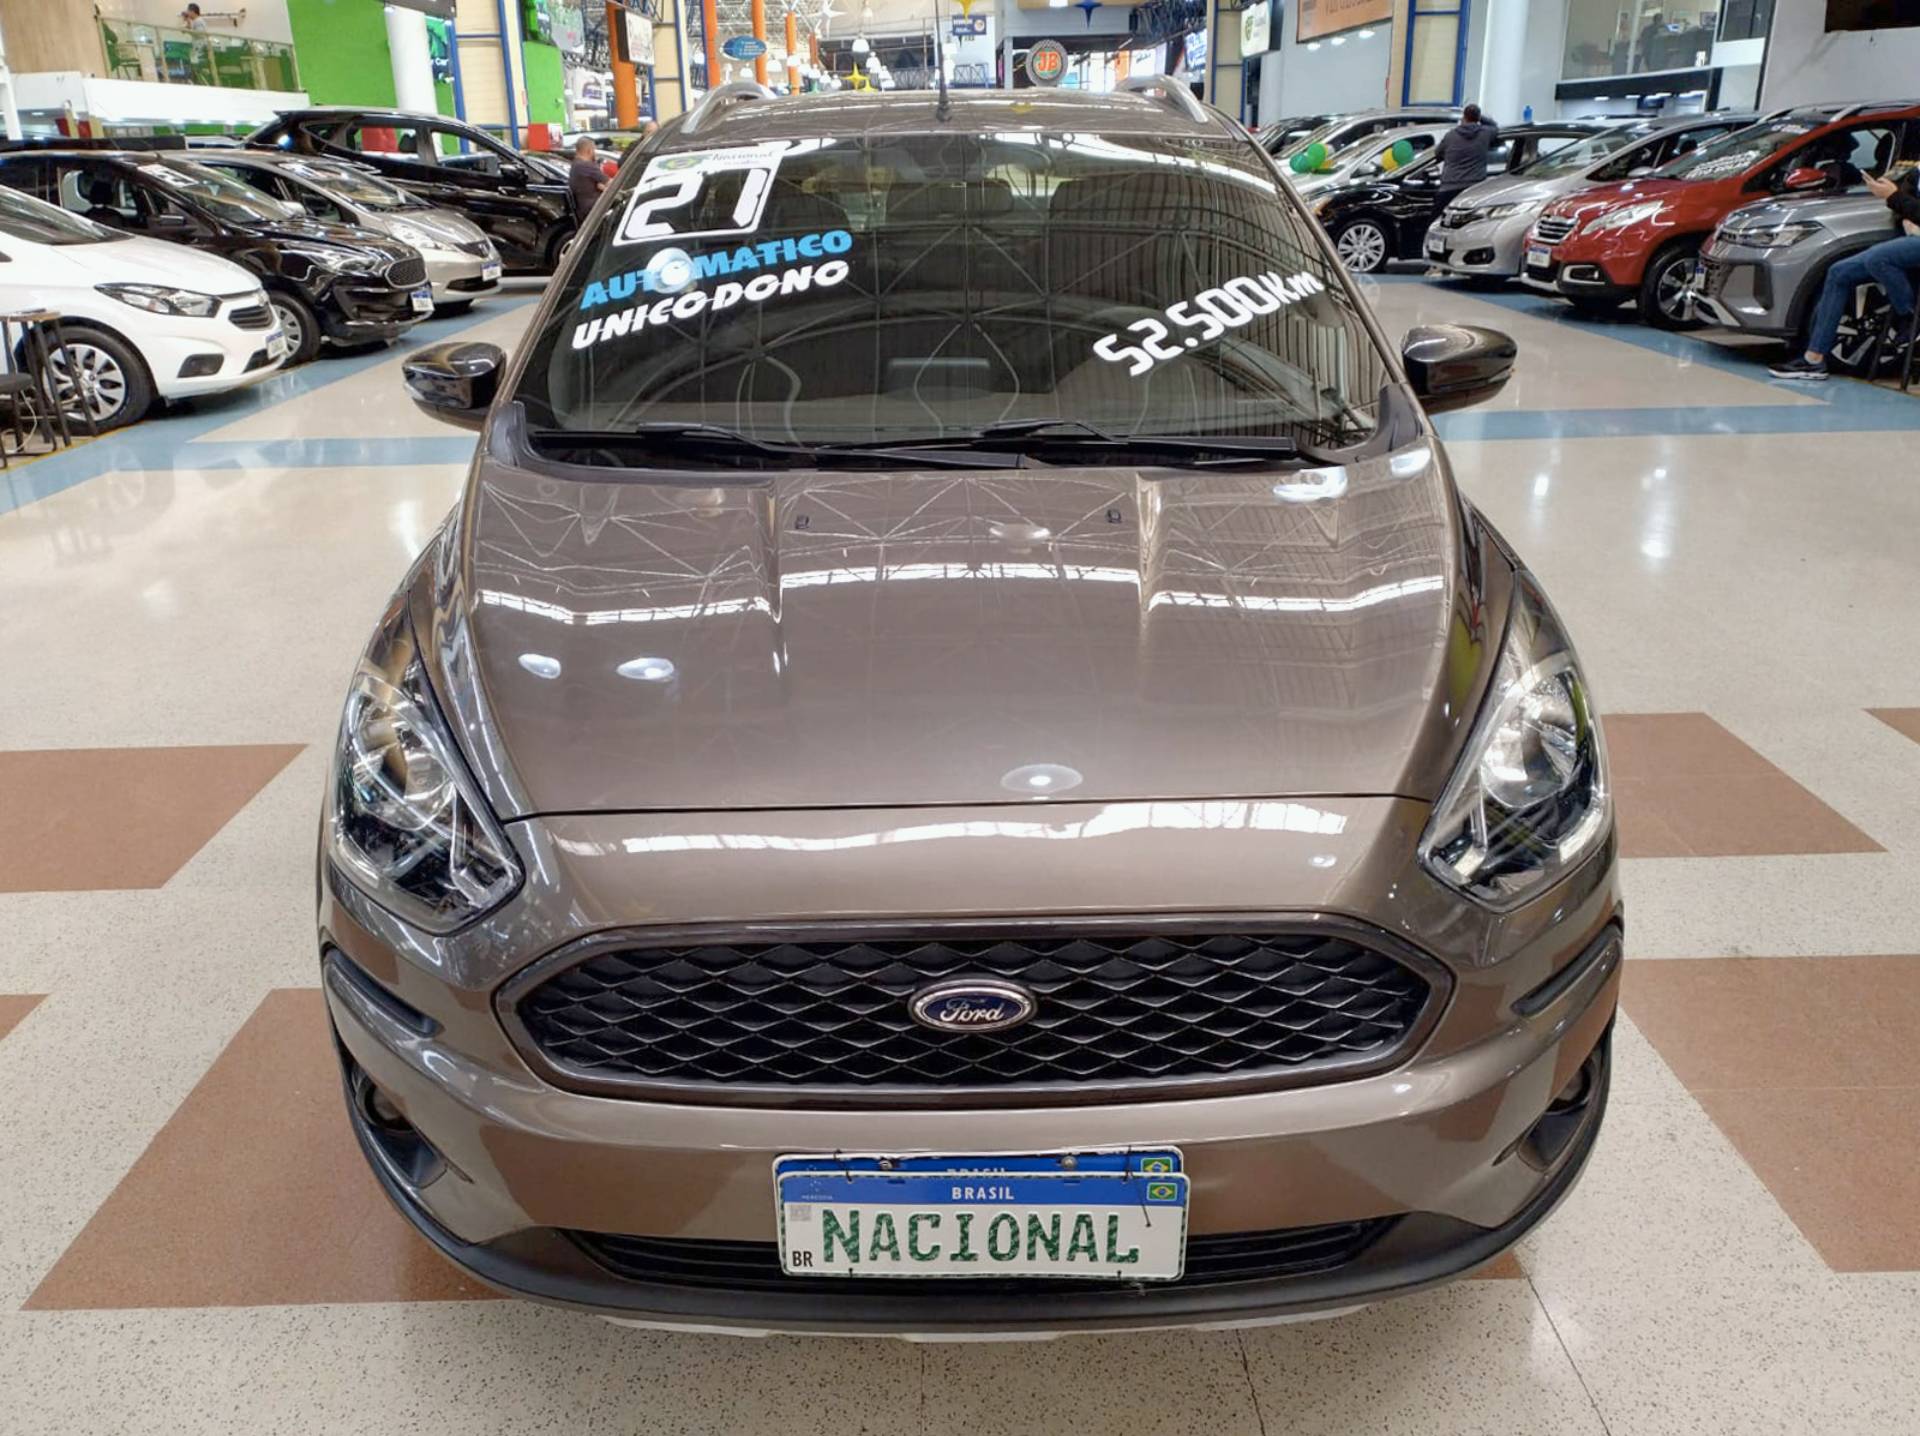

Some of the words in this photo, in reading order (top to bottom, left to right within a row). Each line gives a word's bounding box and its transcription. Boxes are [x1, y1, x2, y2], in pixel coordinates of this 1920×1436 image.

[1038, 51, 1058, 71] JB
[580, 230, 853, 310] AUTOMATICO
[939, 997, 1005, 1022] Ford
[951, 1186, 1015, 1200] BRASIL
[821, 1208, 1140, 1264] NACIONAL
[791, 1250, 814, 1267] BR
